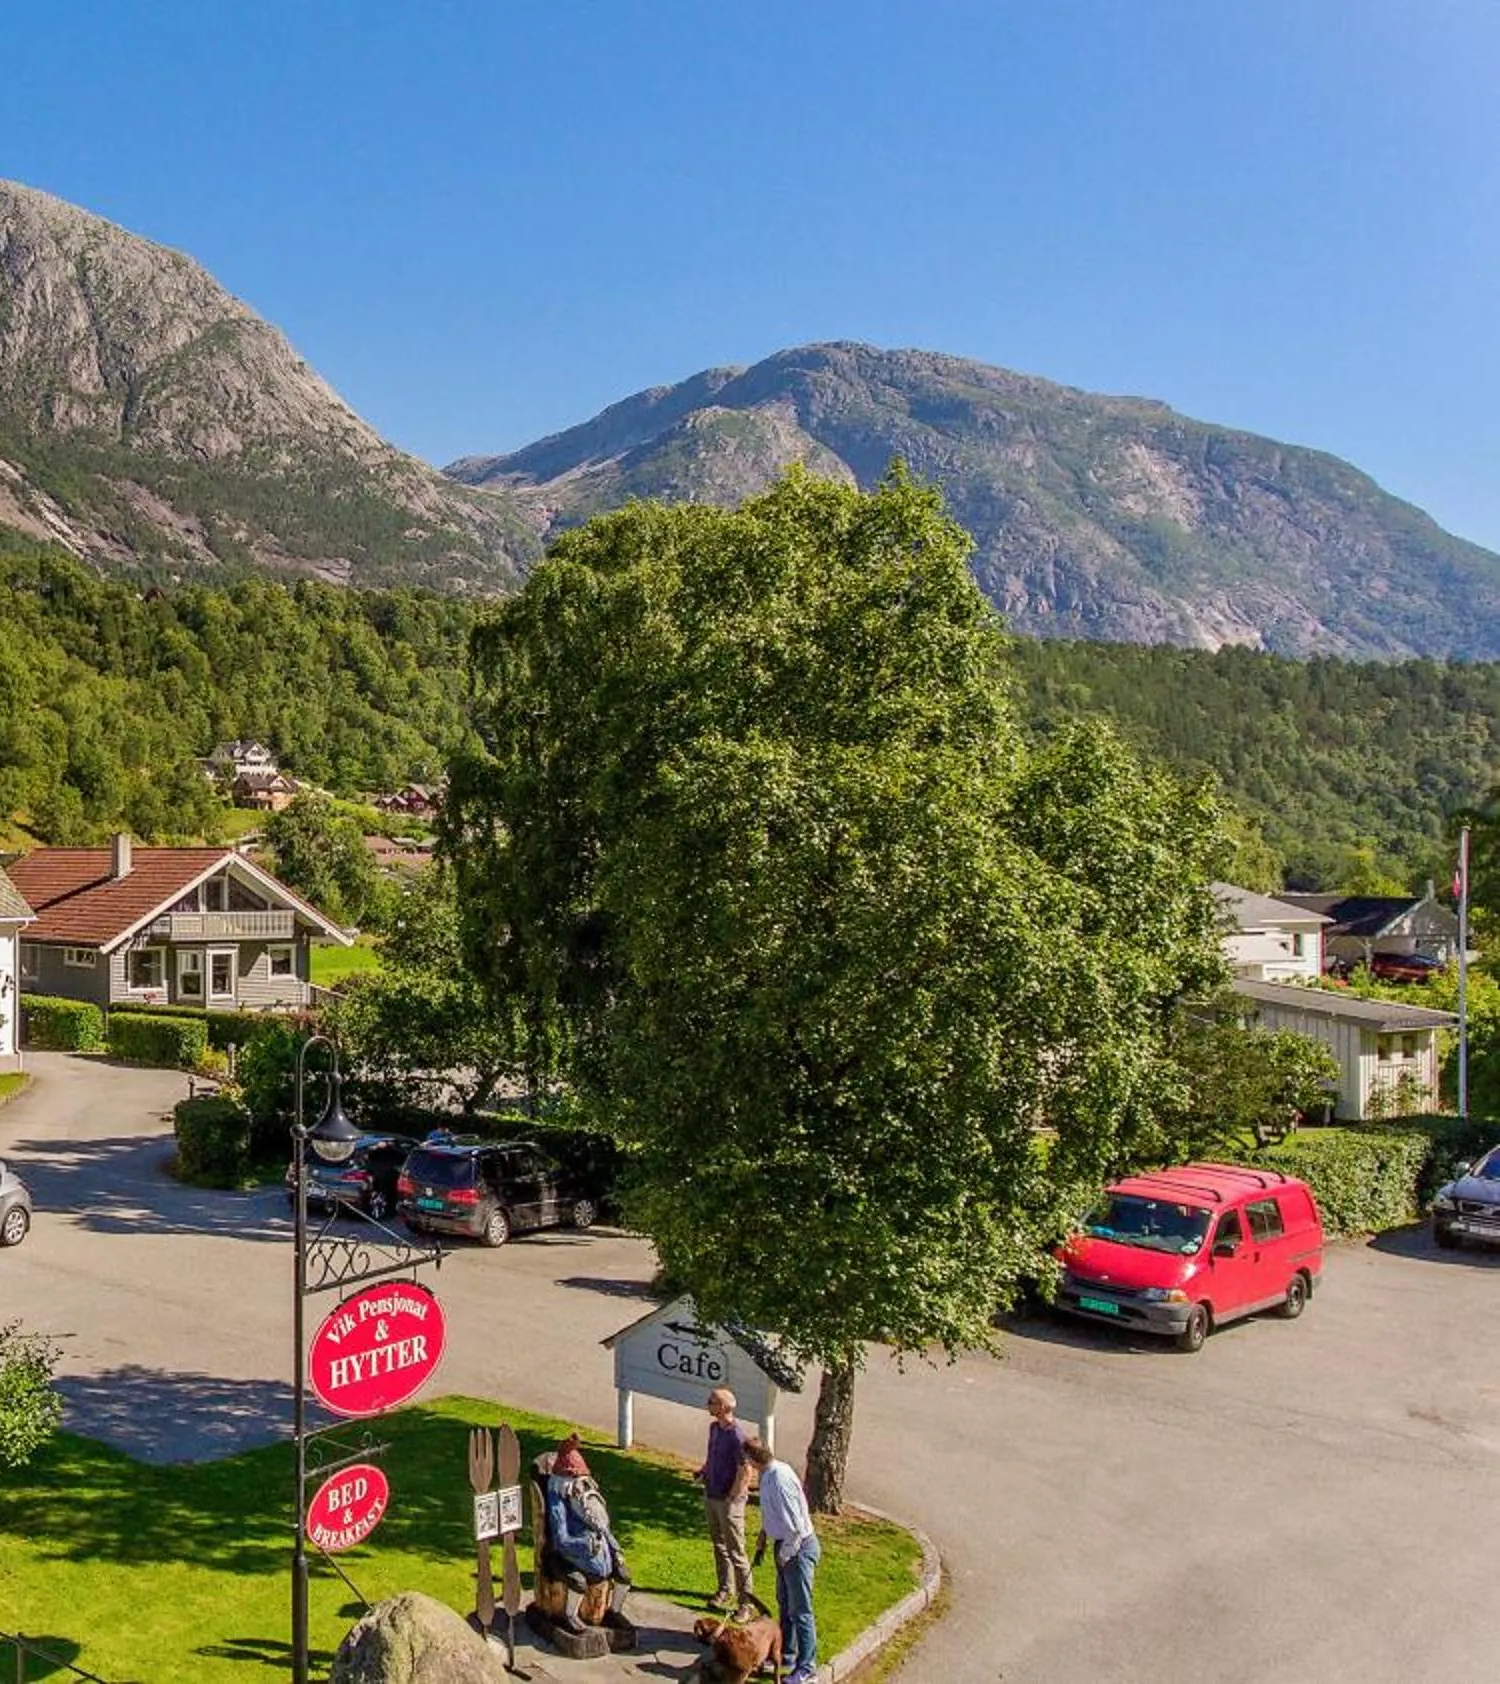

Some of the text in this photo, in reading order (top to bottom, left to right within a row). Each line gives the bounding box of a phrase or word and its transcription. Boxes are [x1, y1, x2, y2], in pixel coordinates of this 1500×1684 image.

[325, 1290, 429, 1345] Vik Pensjonat
[374, 1318, 389, 1342] &
[329, 1335, 428, 1390] HYTTER
[657, 1343, 721, 1381] Cafe
[327, 1477, 368, 1513] BED
[313, 1496, 384, 1549] BREAKFAST
[342, 1508, 353, 1525] &
